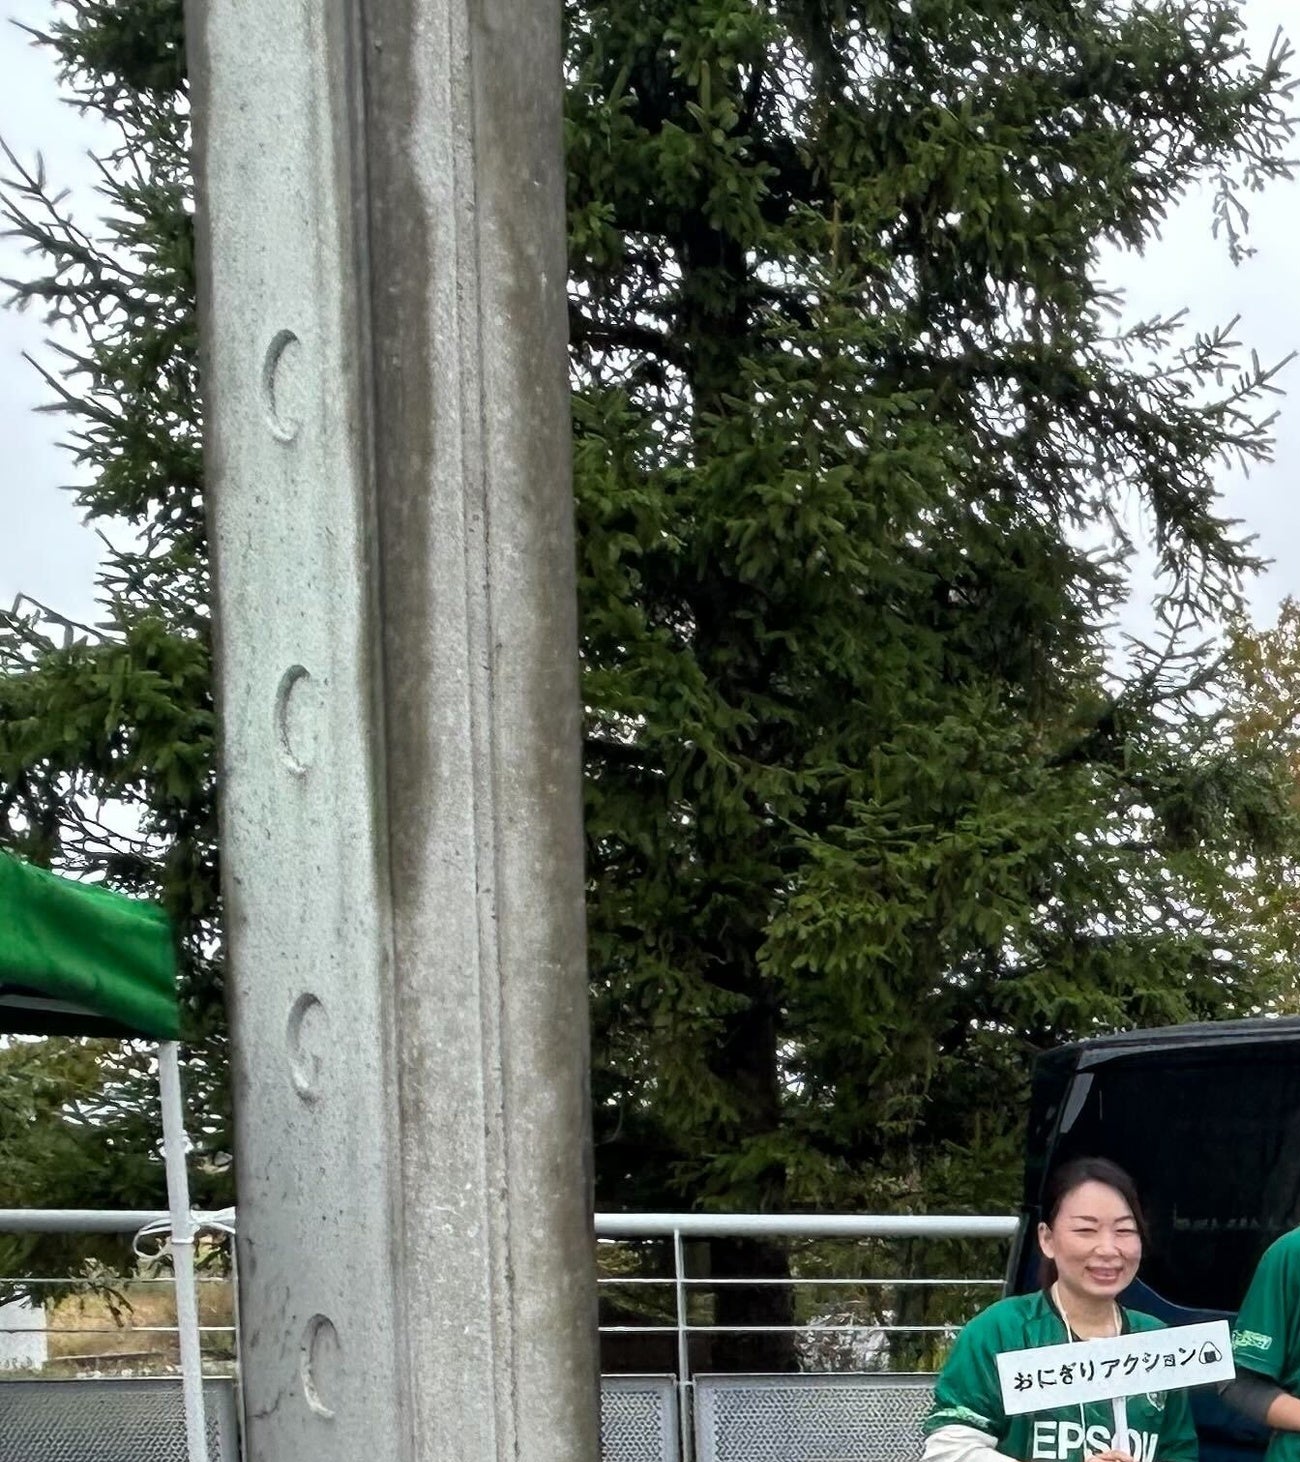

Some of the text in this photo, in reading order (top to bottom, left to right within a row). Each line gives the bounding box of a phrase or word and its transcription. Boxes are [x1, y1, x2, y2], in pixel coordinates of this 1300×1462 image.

[1013, 1346, 1196, 1392] おにぎりアクション
